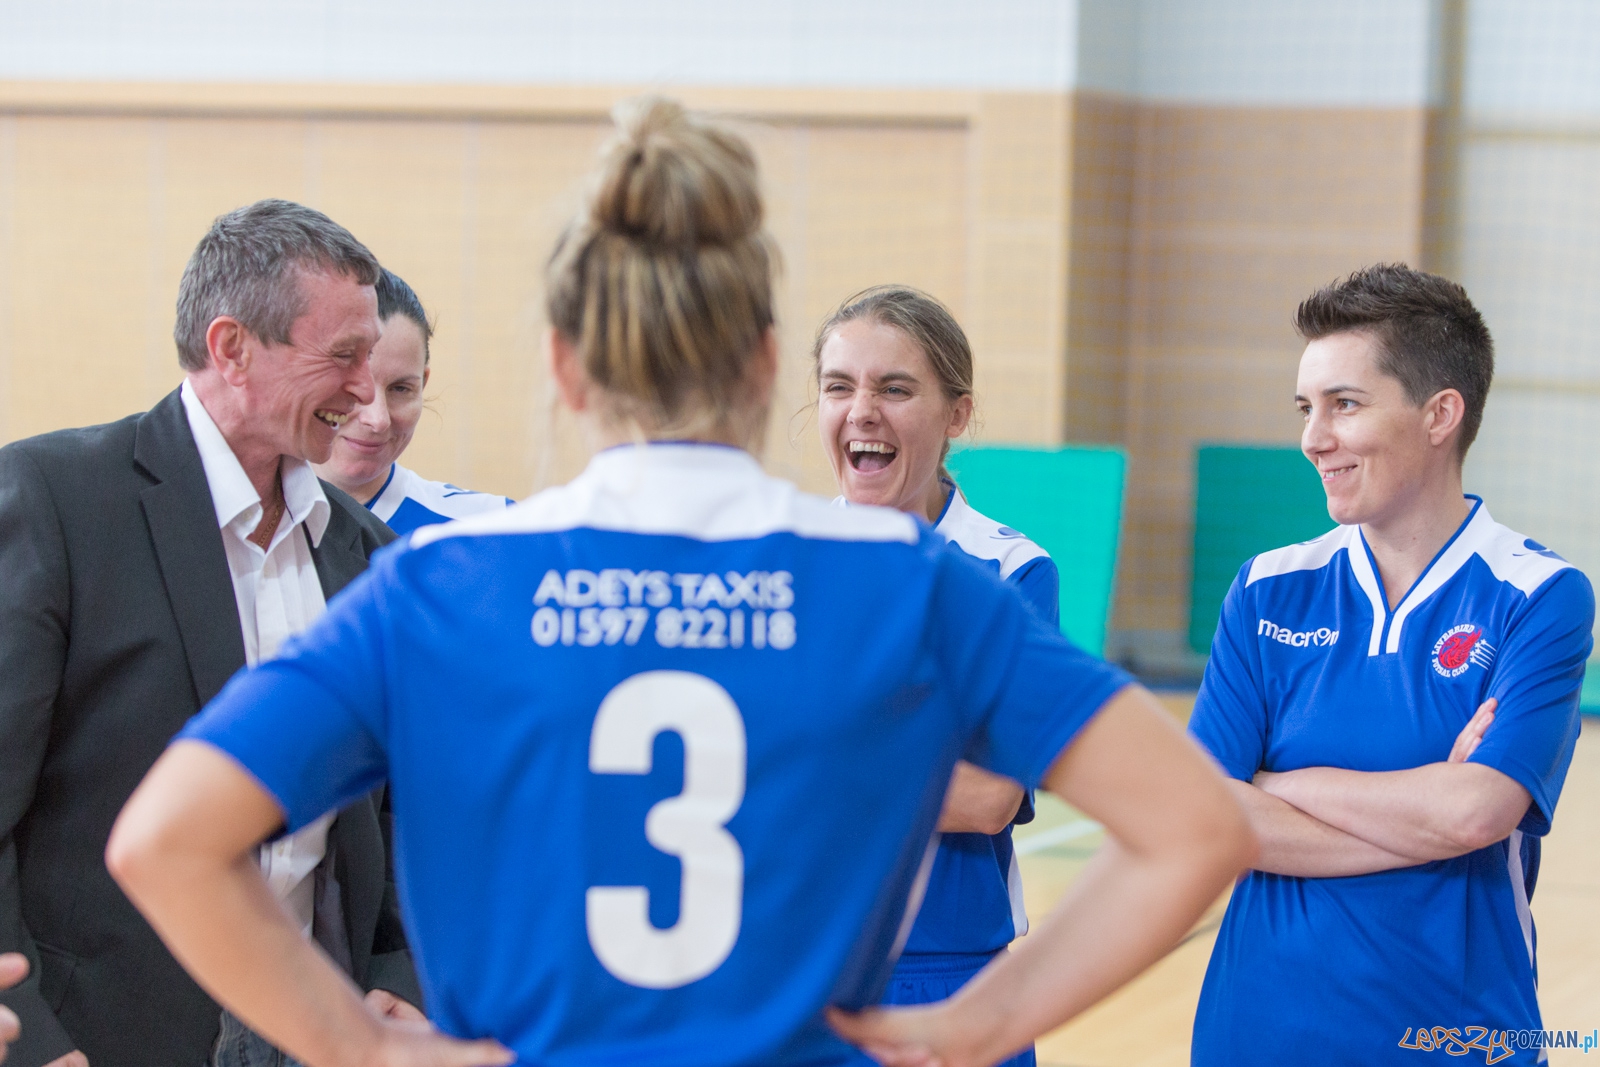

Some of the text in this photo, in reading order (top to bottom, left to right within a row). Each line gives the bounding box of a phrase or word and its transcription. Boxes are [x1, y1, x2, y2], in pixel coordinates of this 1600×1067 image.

[533, 569, 794, 609] ADEYS TAXIS
[531, 607, 797, 650] 01597 822118
[1257, 618, 1340, 647] macron
[1431, 657, 1469, 678] FUTSAL CLUB
[585, 669, 747, 991] 3
